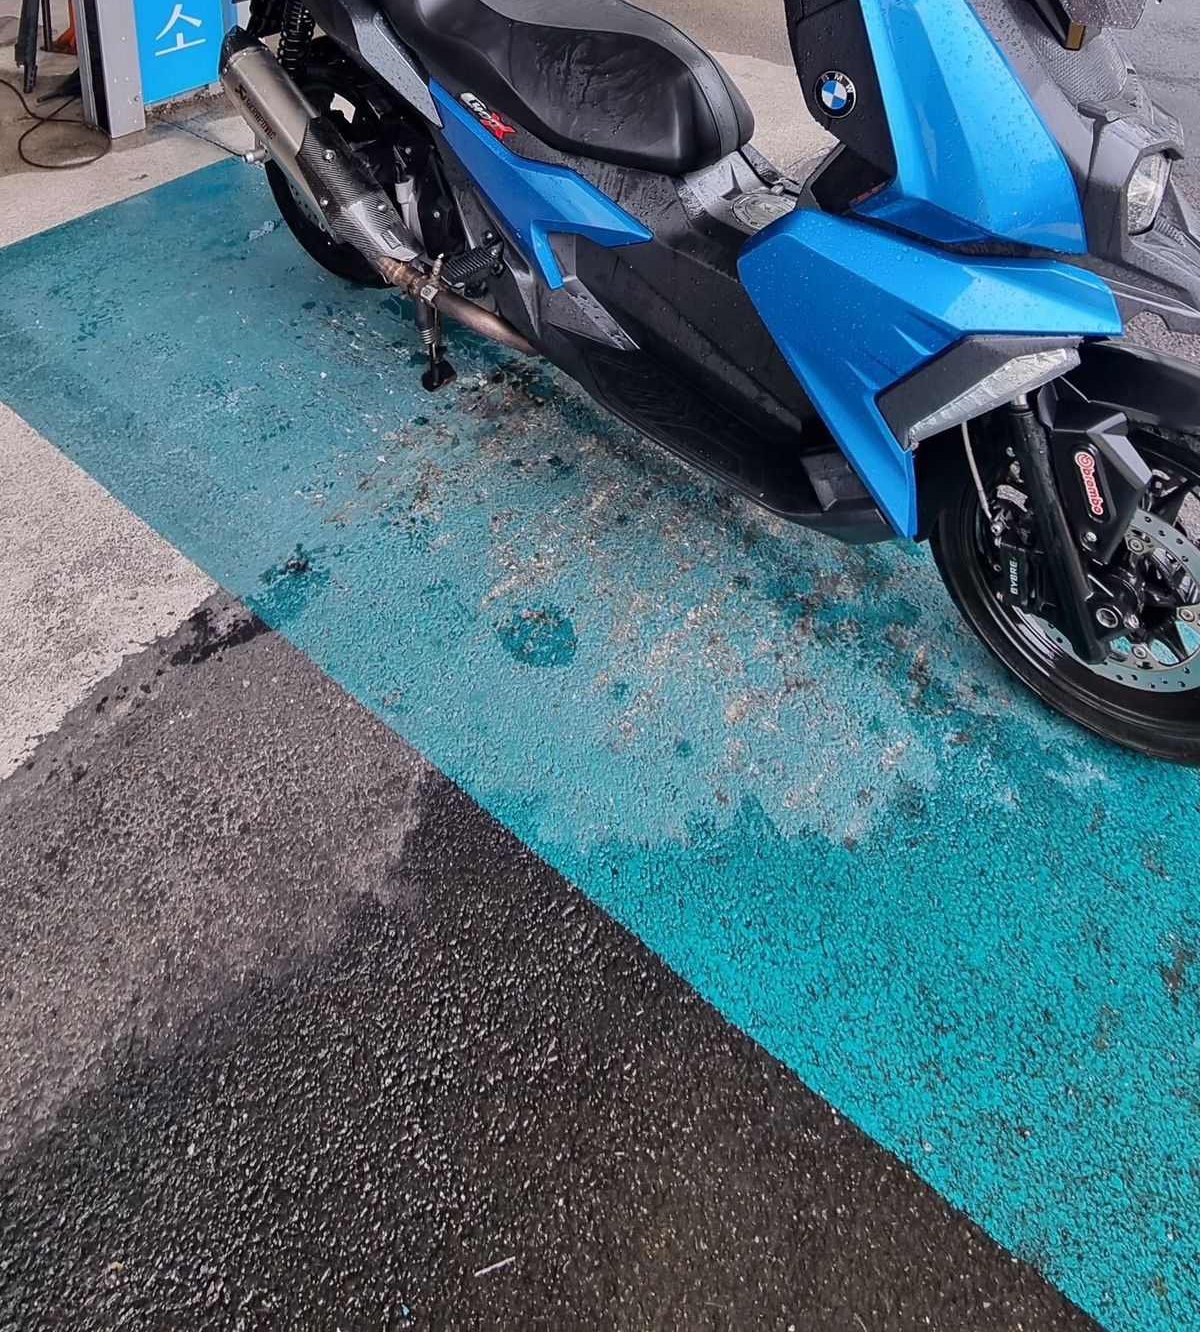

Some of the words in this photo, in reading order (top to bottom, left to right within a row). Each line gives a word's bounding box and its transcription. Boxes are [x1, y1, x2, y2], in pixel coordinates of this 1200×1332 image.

[821, 73, 854, 93] BMW
[1080, 467, 1104, 516] brembo
[1010, 559, 1019, 595] BYBRE
